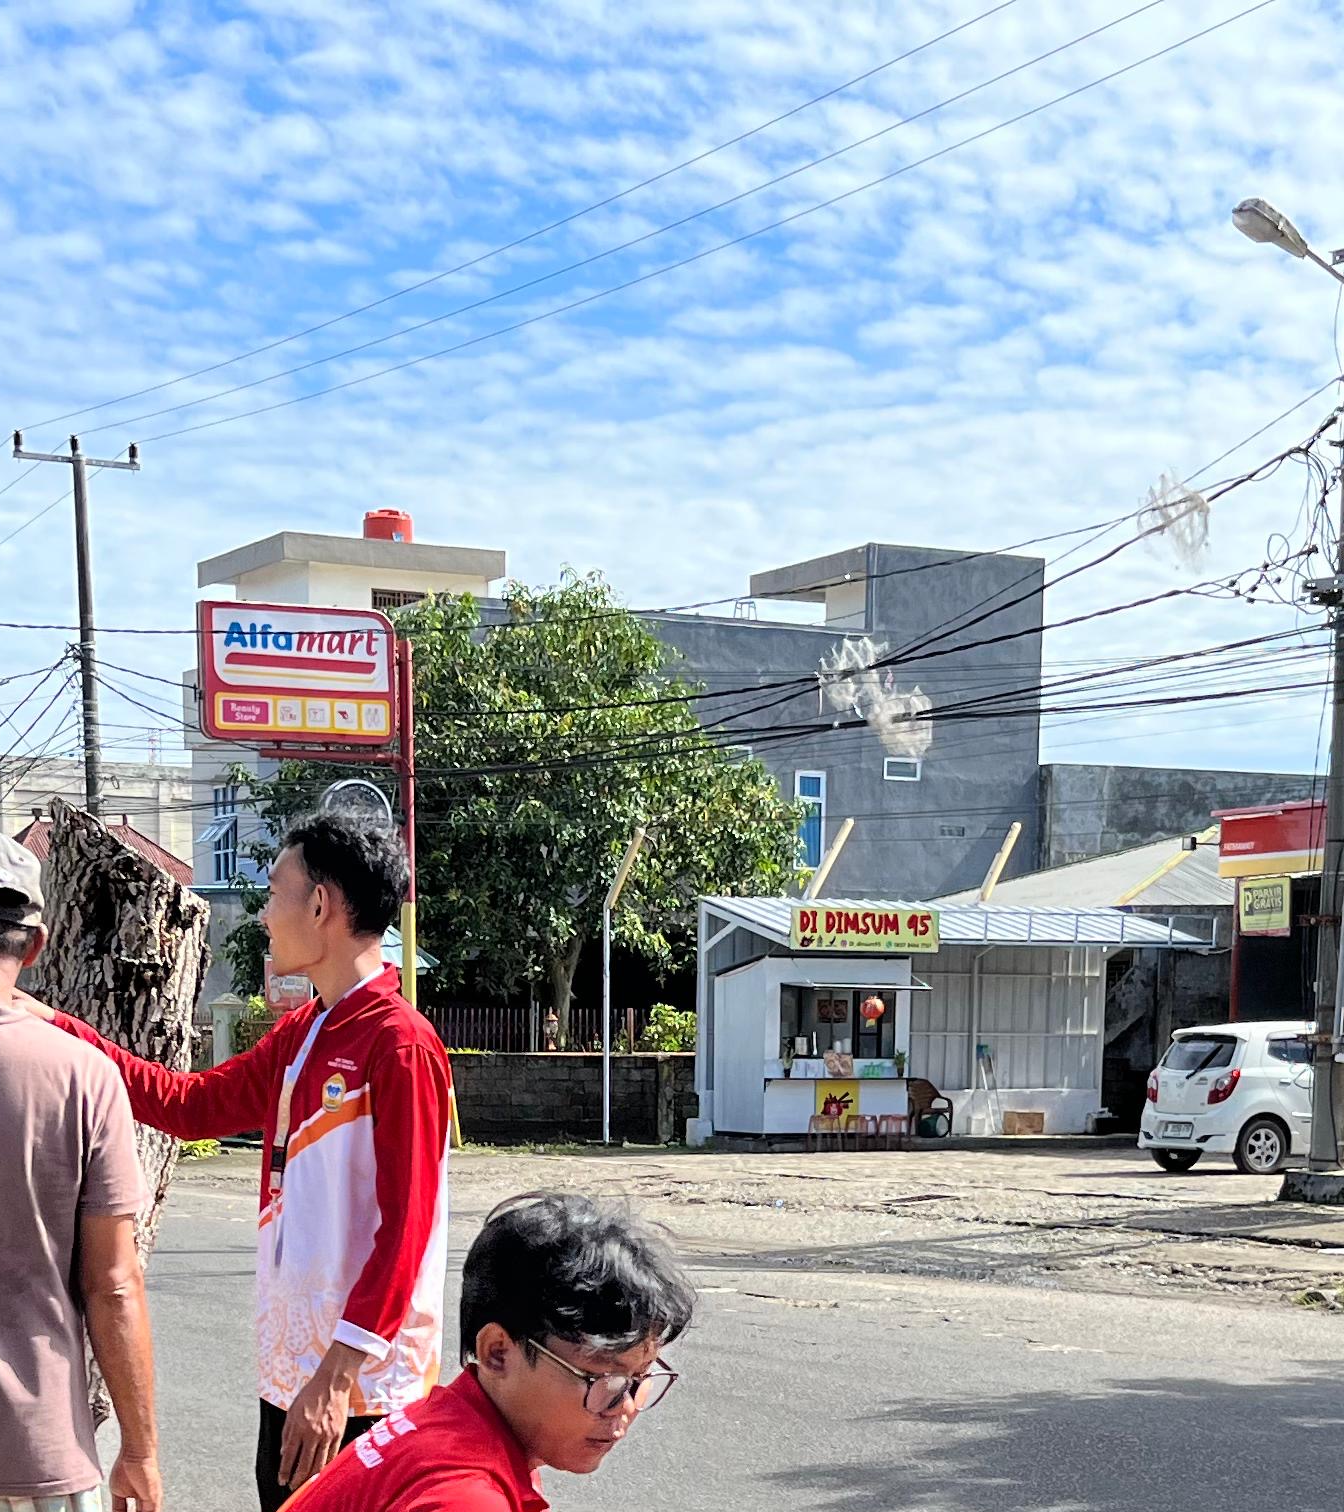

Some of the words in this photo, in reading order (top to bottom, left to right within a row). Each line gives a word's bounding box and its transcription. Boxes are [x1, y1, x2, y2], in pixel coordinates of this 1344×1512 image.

[223, 621, 379, 657] Alfamart
[1252, 886, 1282, 899] PARKIR
[799, 910, 818, 934] DI
[825, 910, 900, 936] DIMSUM
[906, 913, 932, 937] 95
